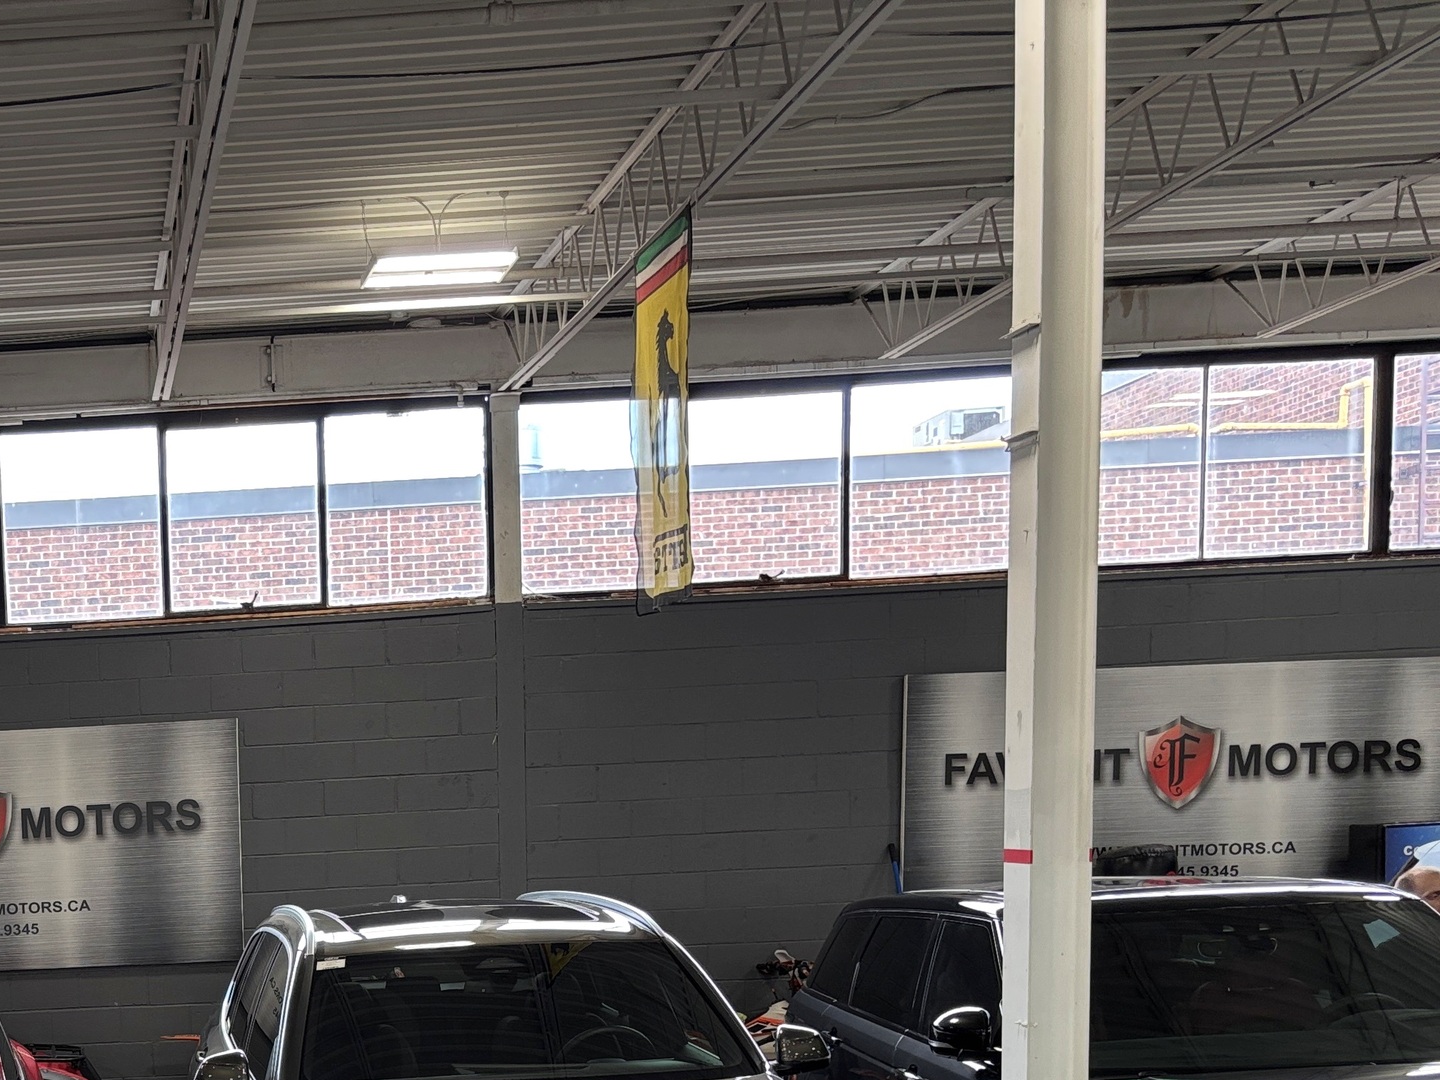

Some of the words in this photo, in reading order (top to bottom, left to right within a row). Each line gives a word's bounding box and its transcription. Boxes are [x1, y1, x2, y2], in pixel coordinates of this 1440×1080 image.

[944, 748, 1131, 786] FAIT
[1228, 738, 1422, 779] MOTORS
[20, 799, 201, 840] MOTORS
[1092, 842, 1297, 858] ITMOTORS.CA
